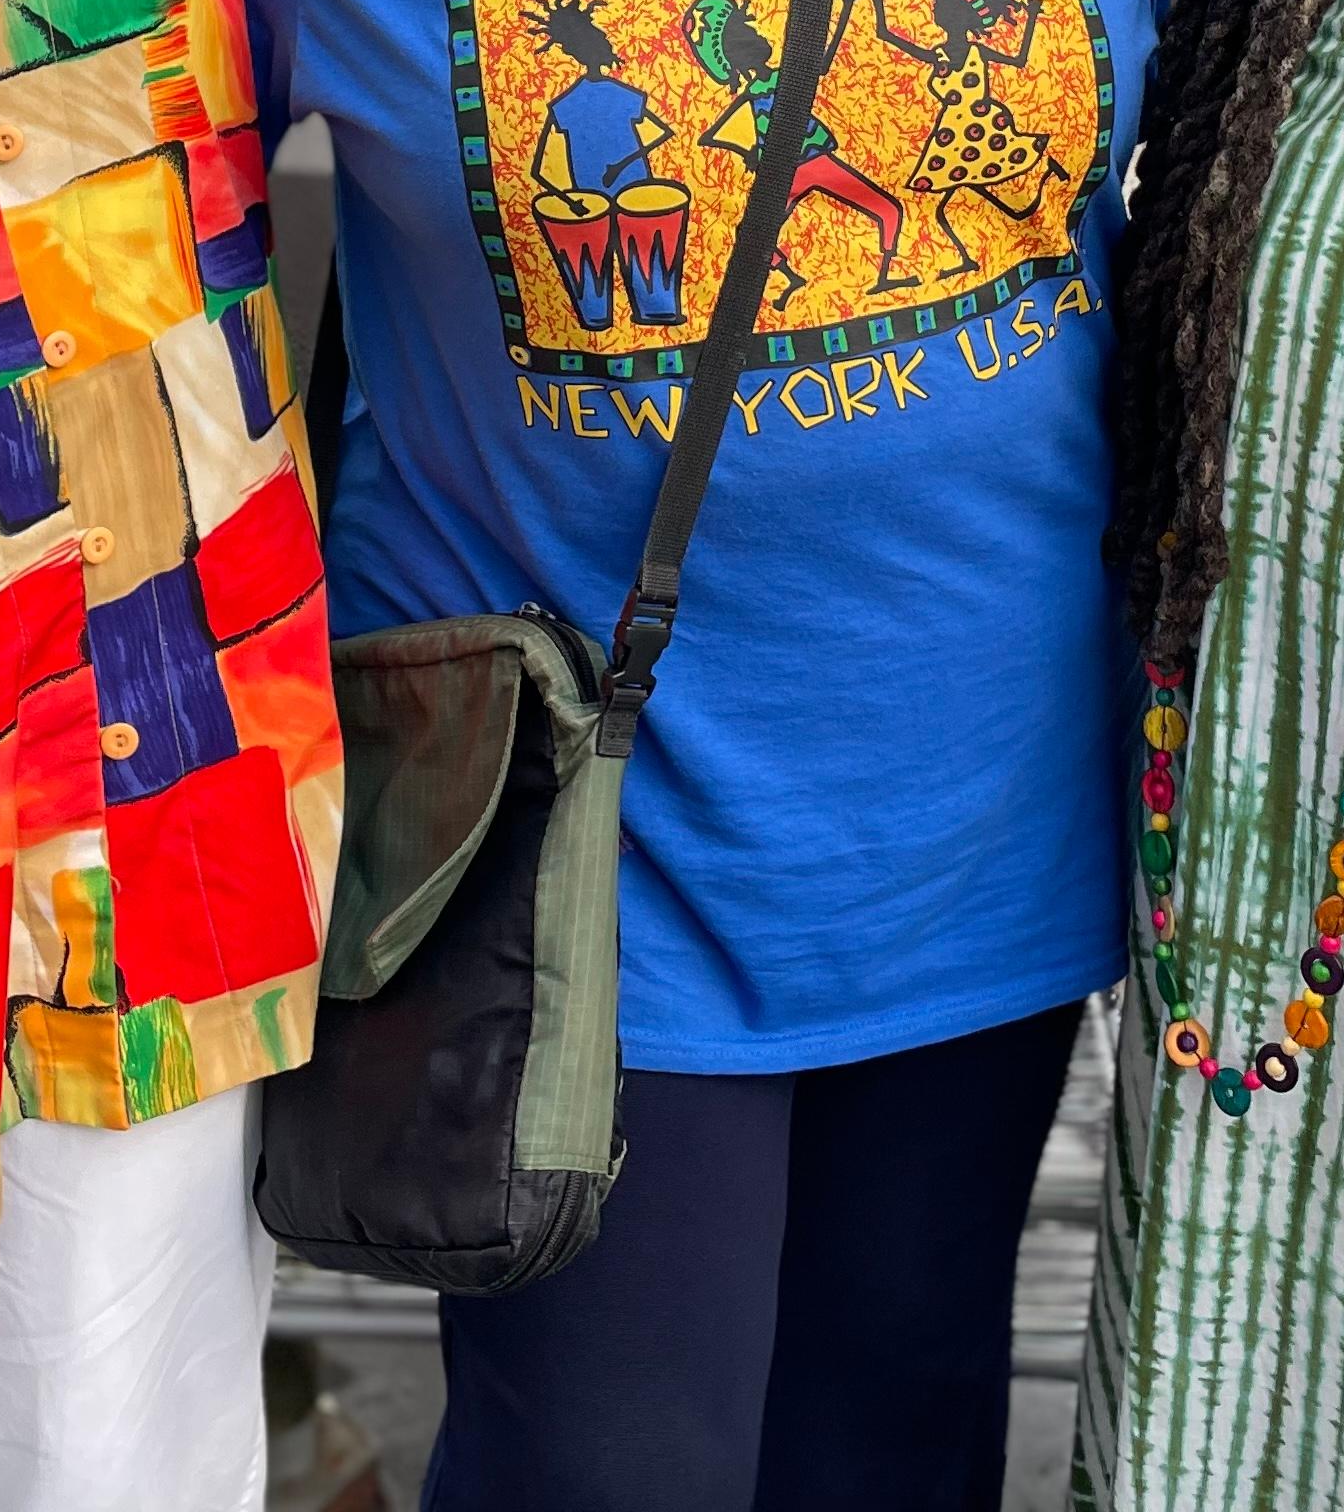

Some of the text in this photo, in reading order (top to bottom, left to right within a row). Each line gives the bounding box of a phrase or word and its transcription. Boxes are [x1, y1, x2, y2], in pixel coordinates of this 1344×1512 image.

[516, 279, 1103, 444] NEW YORK U.S.A.
